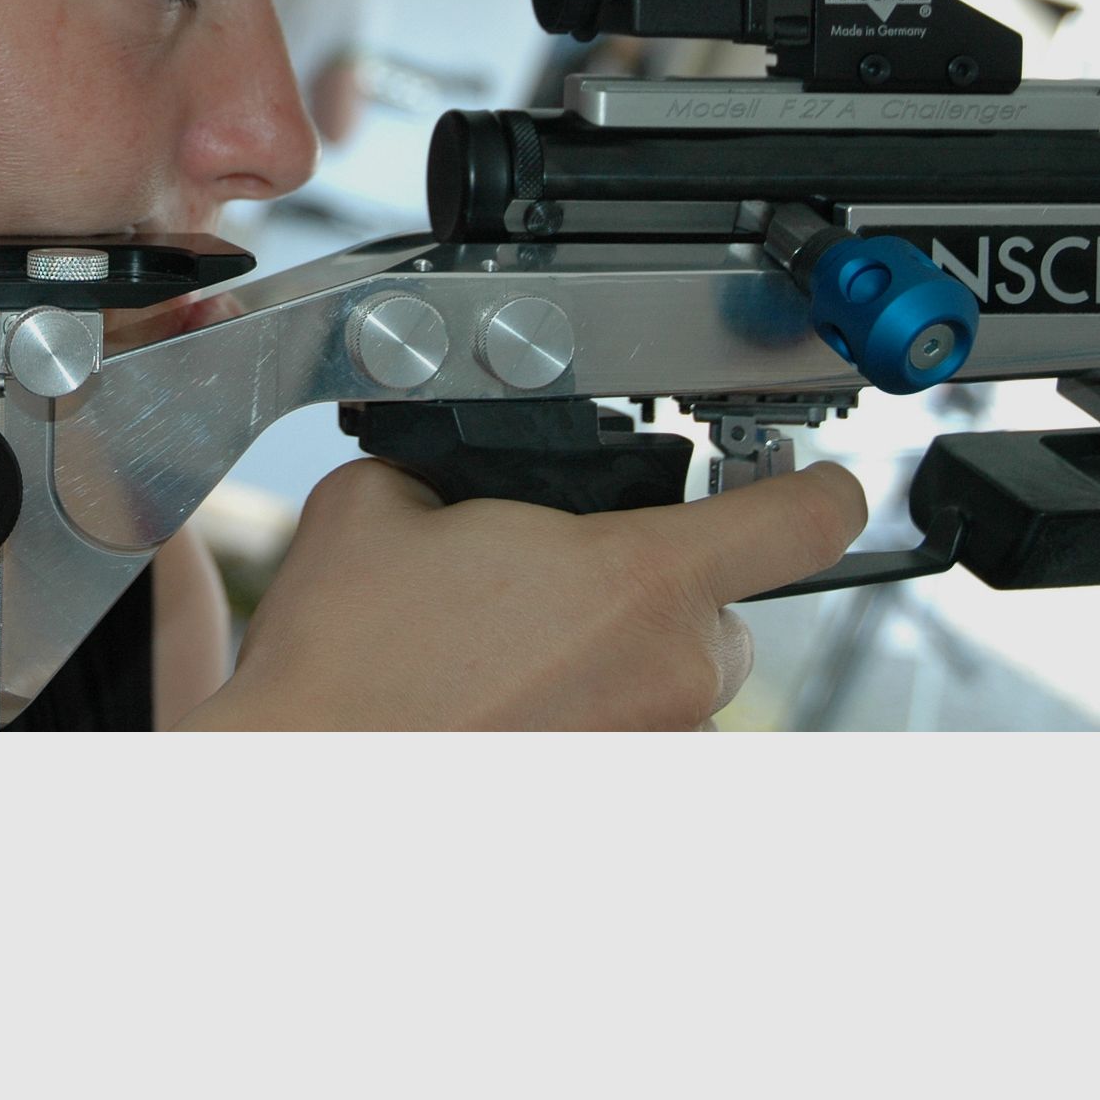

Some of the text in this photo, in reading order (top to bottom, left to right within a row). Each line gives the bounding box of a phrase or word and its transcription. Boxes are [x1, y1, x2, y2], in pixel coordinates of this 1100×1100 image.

[831, 24, 927, 39] Made in Germany
[666, 99, 761, 119] Modell
[881, 99, 1028, 125] Challenger
[931, 236, 1100, 304] NSC
